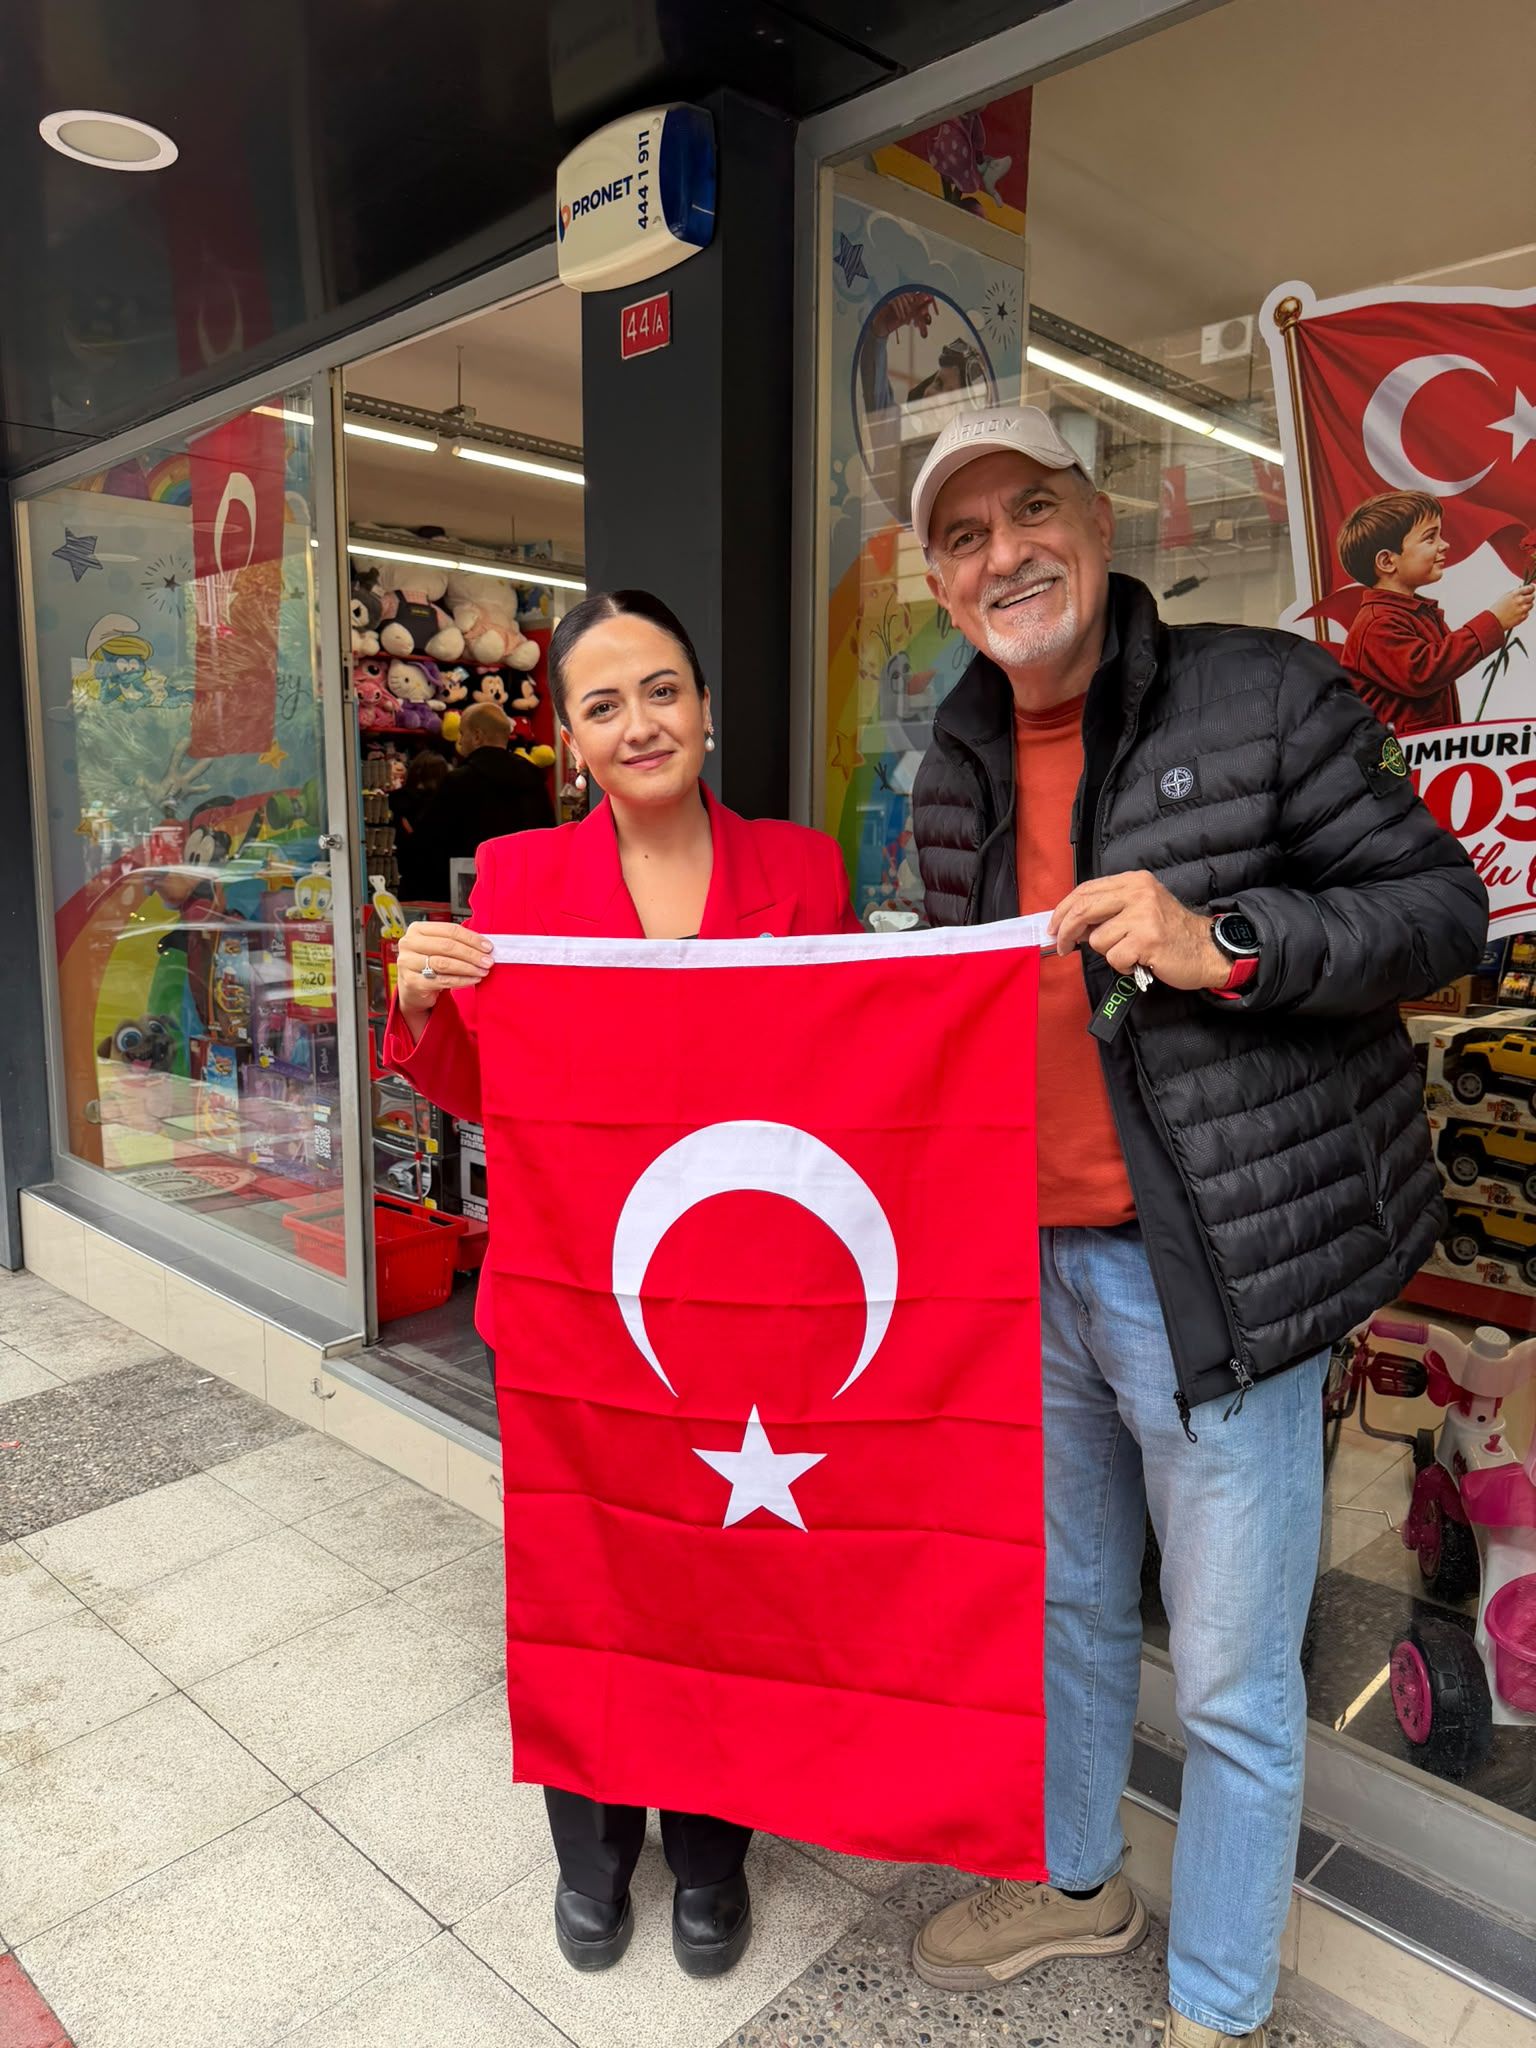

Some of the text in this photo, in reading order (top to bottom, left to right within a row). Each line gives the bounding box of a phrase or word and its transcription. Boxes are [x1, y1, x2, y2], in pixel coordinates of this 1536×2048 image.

[572, 174, 633, 220] PRONET
[637, 130, 650, 230] 444 1 911
[626, 302, 664, 342] 44/A
[1405, 724, 1536, 766] MHURİ
[1468, 841, 1522, 887] tlu
[1102, 992, 1128, 1020] bar
